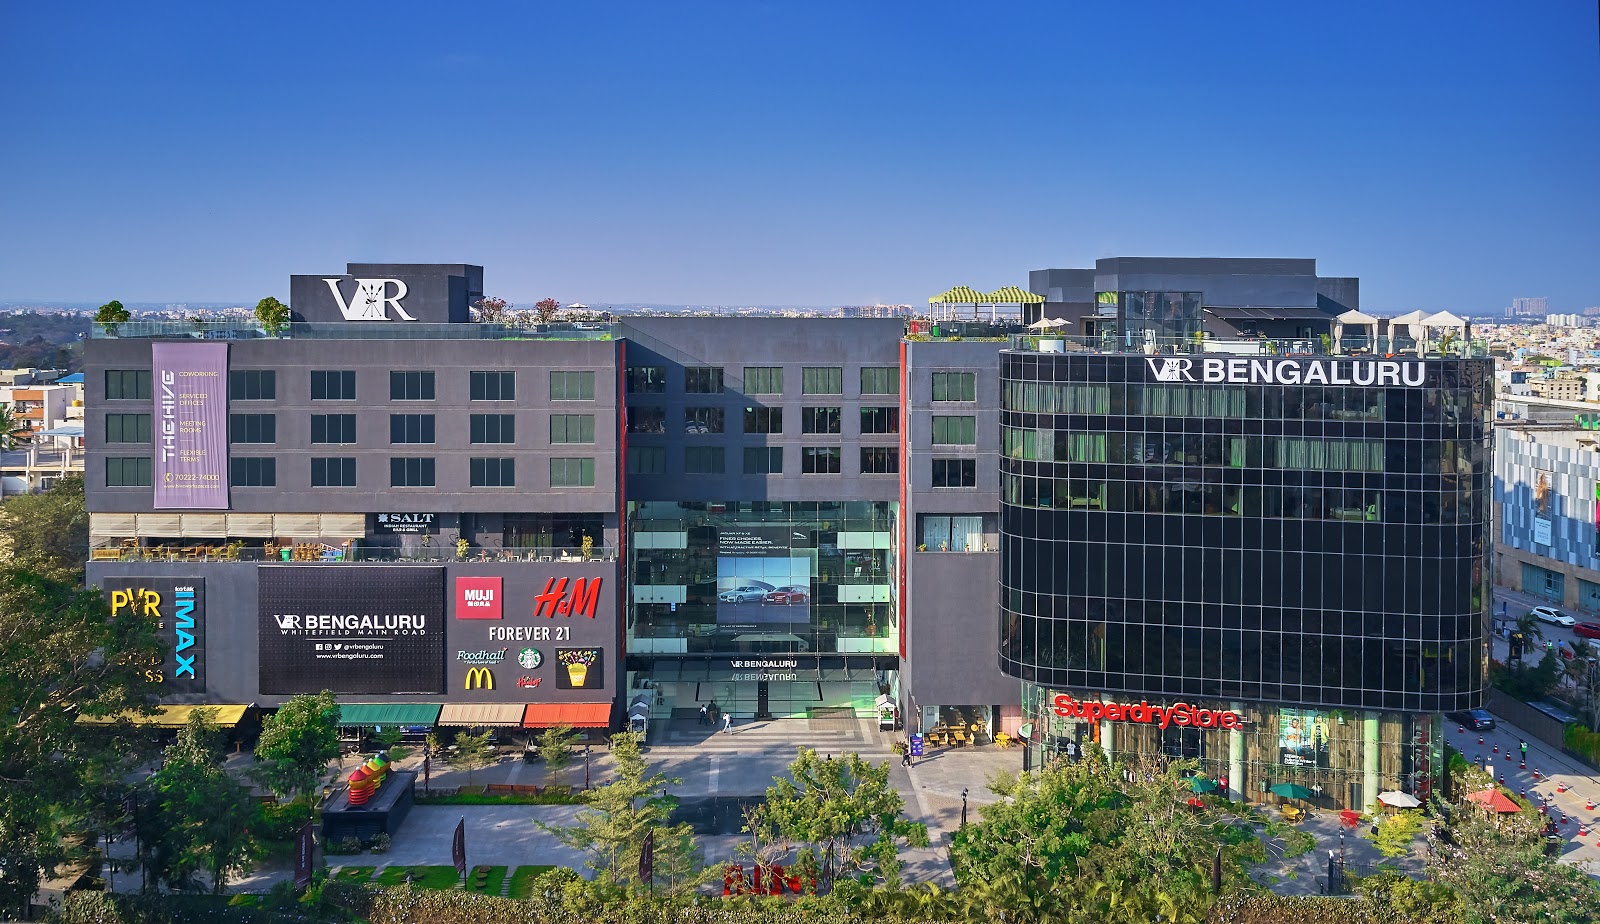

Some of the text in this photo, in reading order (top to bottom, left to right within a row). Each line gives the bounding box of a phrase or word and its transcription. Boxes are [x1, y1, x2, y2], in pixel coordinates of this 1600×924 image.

[322, 278, 418, 321] VR
[1145, 357, 1426, 387] VR BENGALURU
[390, 513, 434, 523] SALT
[111, 588, 161, 617] PVR
[464, 590, 494, 600] MUJI
[533, 577, 601, 618] H&M
[273, 614, 425, 629] VR BENGALURU
[175, 592, 195, 677] IMAX
[489, 627, 570, 641] FOREVER 21
[456, 650, 505, 660] Foodhall
